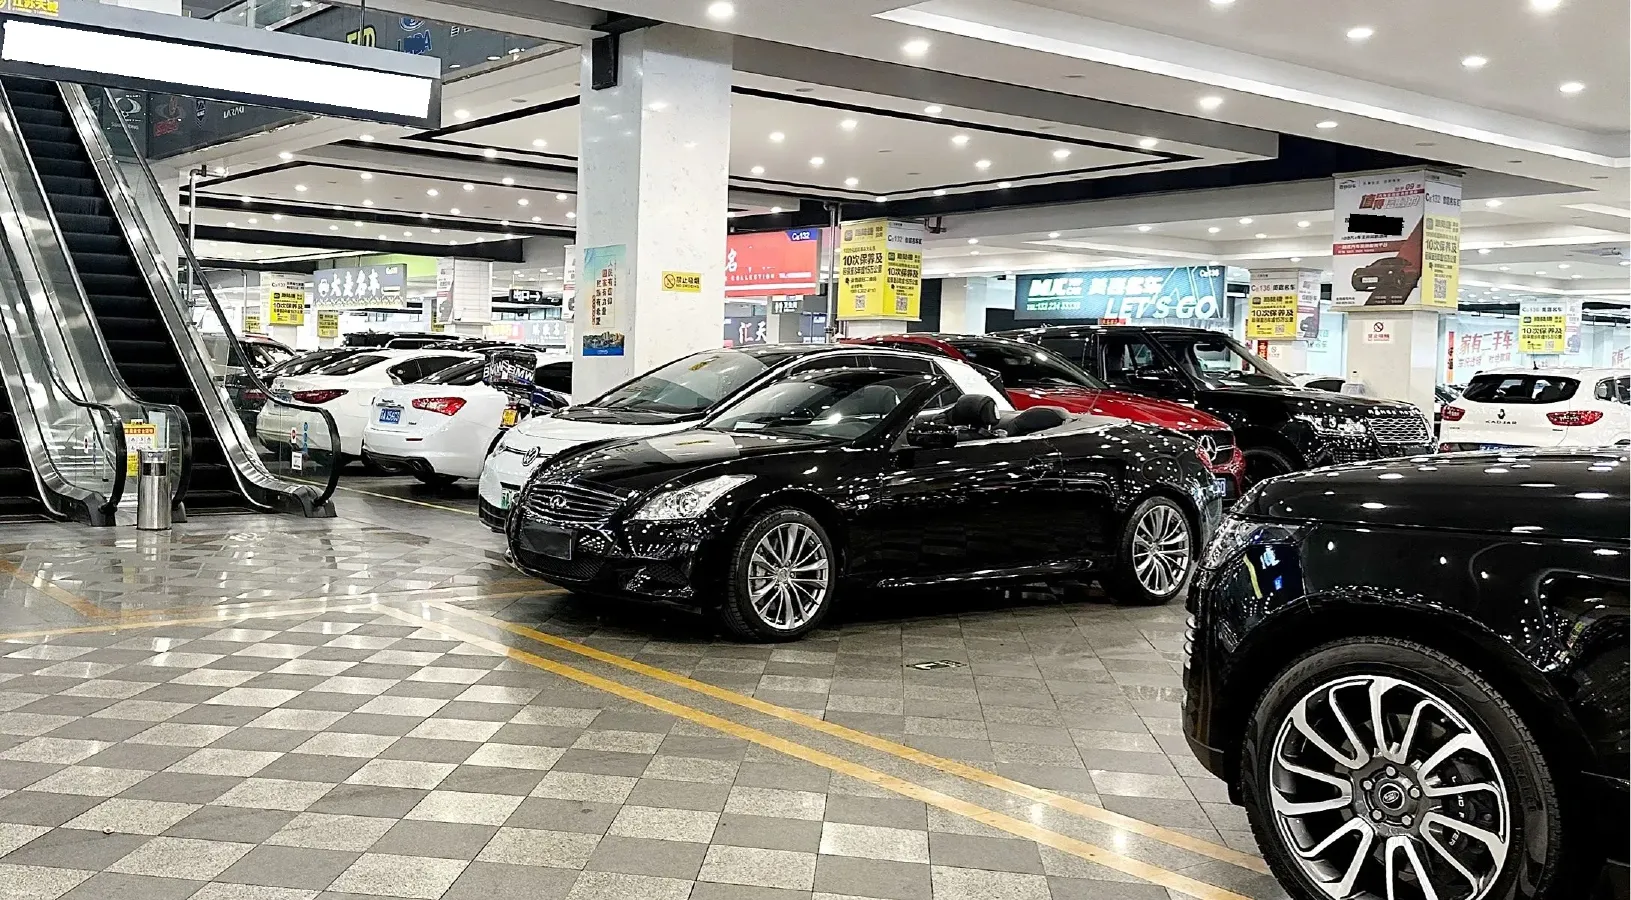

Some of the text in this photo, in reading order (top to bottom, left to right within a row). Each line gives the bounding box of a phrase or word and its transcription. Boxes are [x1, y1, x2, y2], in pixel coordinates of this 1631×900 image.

[842, 252, 883, 266] 10次保养及
[1175, 295, 1218, 319] GO
[1251, 309, 1294, 317] 10次保养及
[1522, 327, 1562, 335] 10次保养及
[508, 365, 533, 382] BMW
